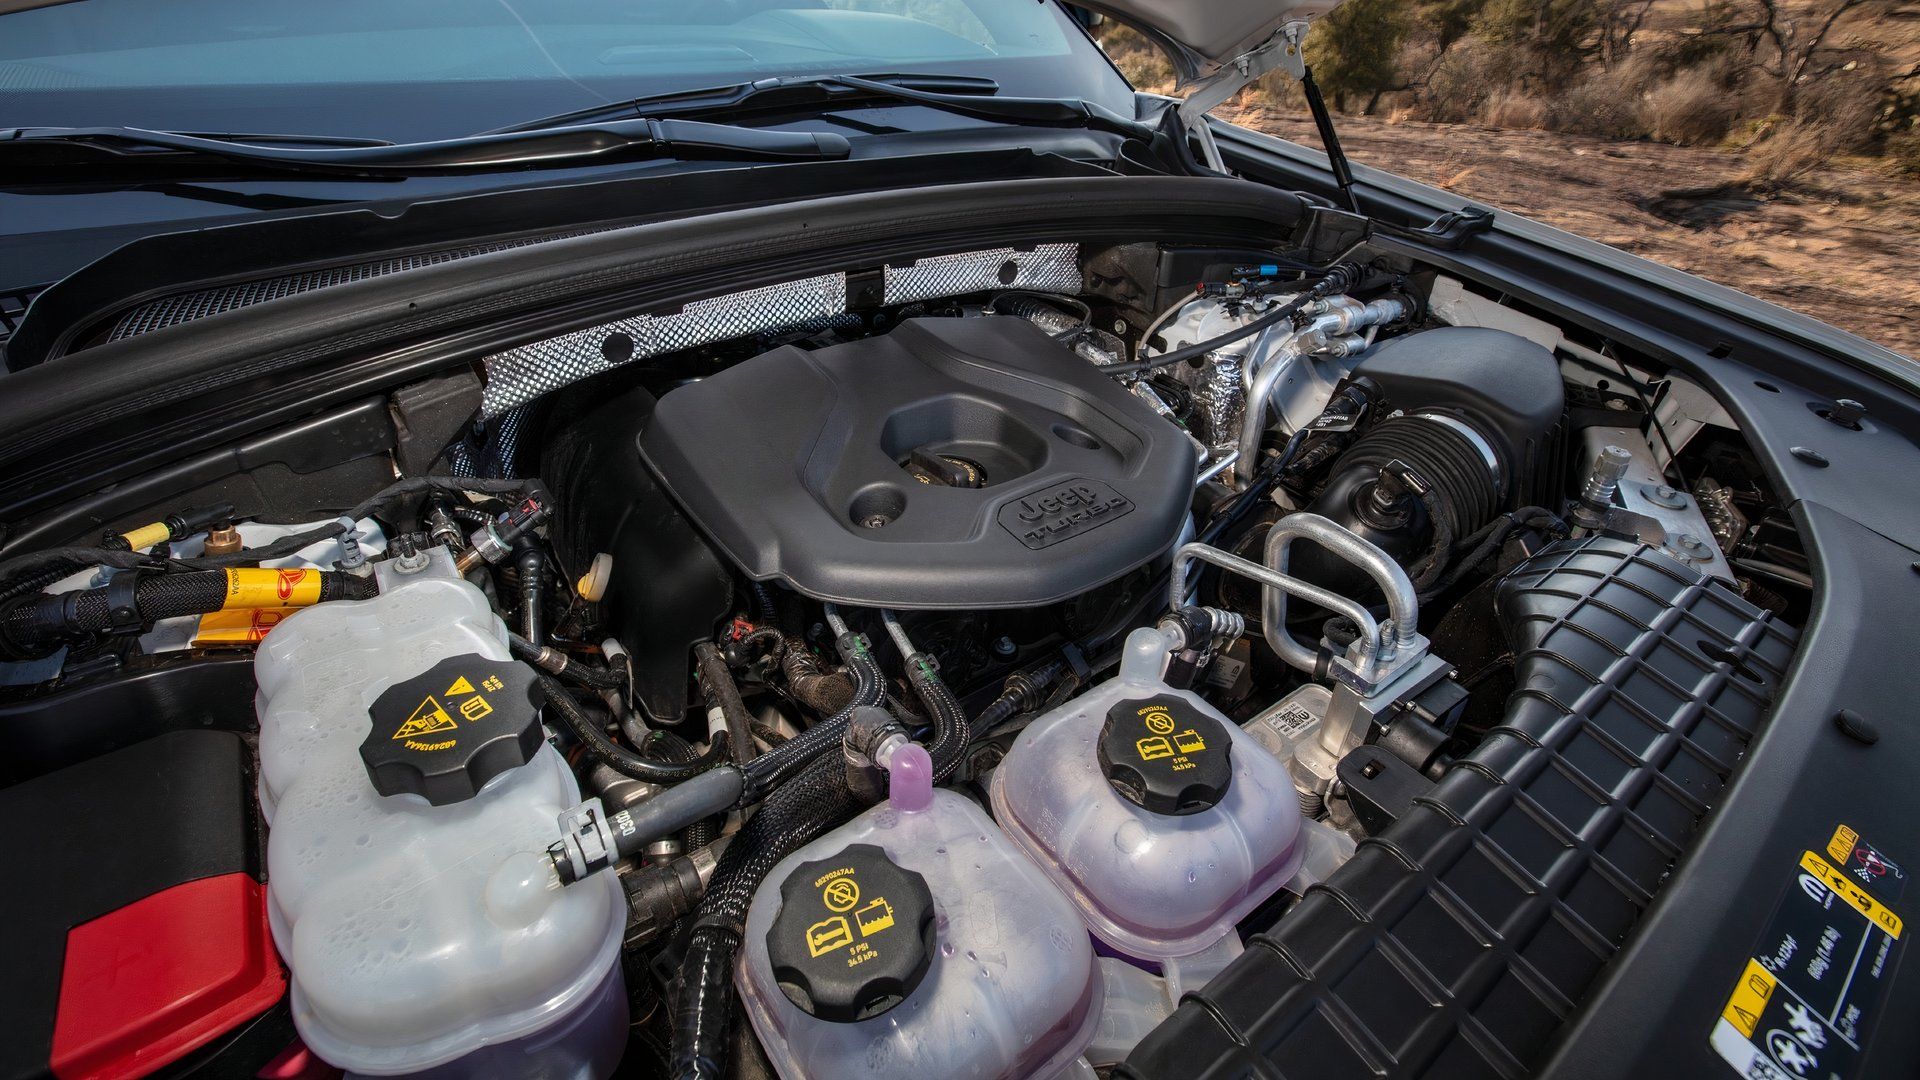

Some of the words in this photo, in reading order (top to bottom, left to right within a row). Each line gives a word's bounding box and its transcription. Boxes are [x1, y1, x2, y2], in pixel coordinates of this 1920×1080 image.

[1018, 487, 1097, 522] Jeep
[1023, 497, 1128, 541] TURBO
[815, 868, 855, 887] 68290247AA
[856, 942, 869, 953] PSI
[847, 954, 864, 968] 34.5
[863, 950, 878, 961] kPa
